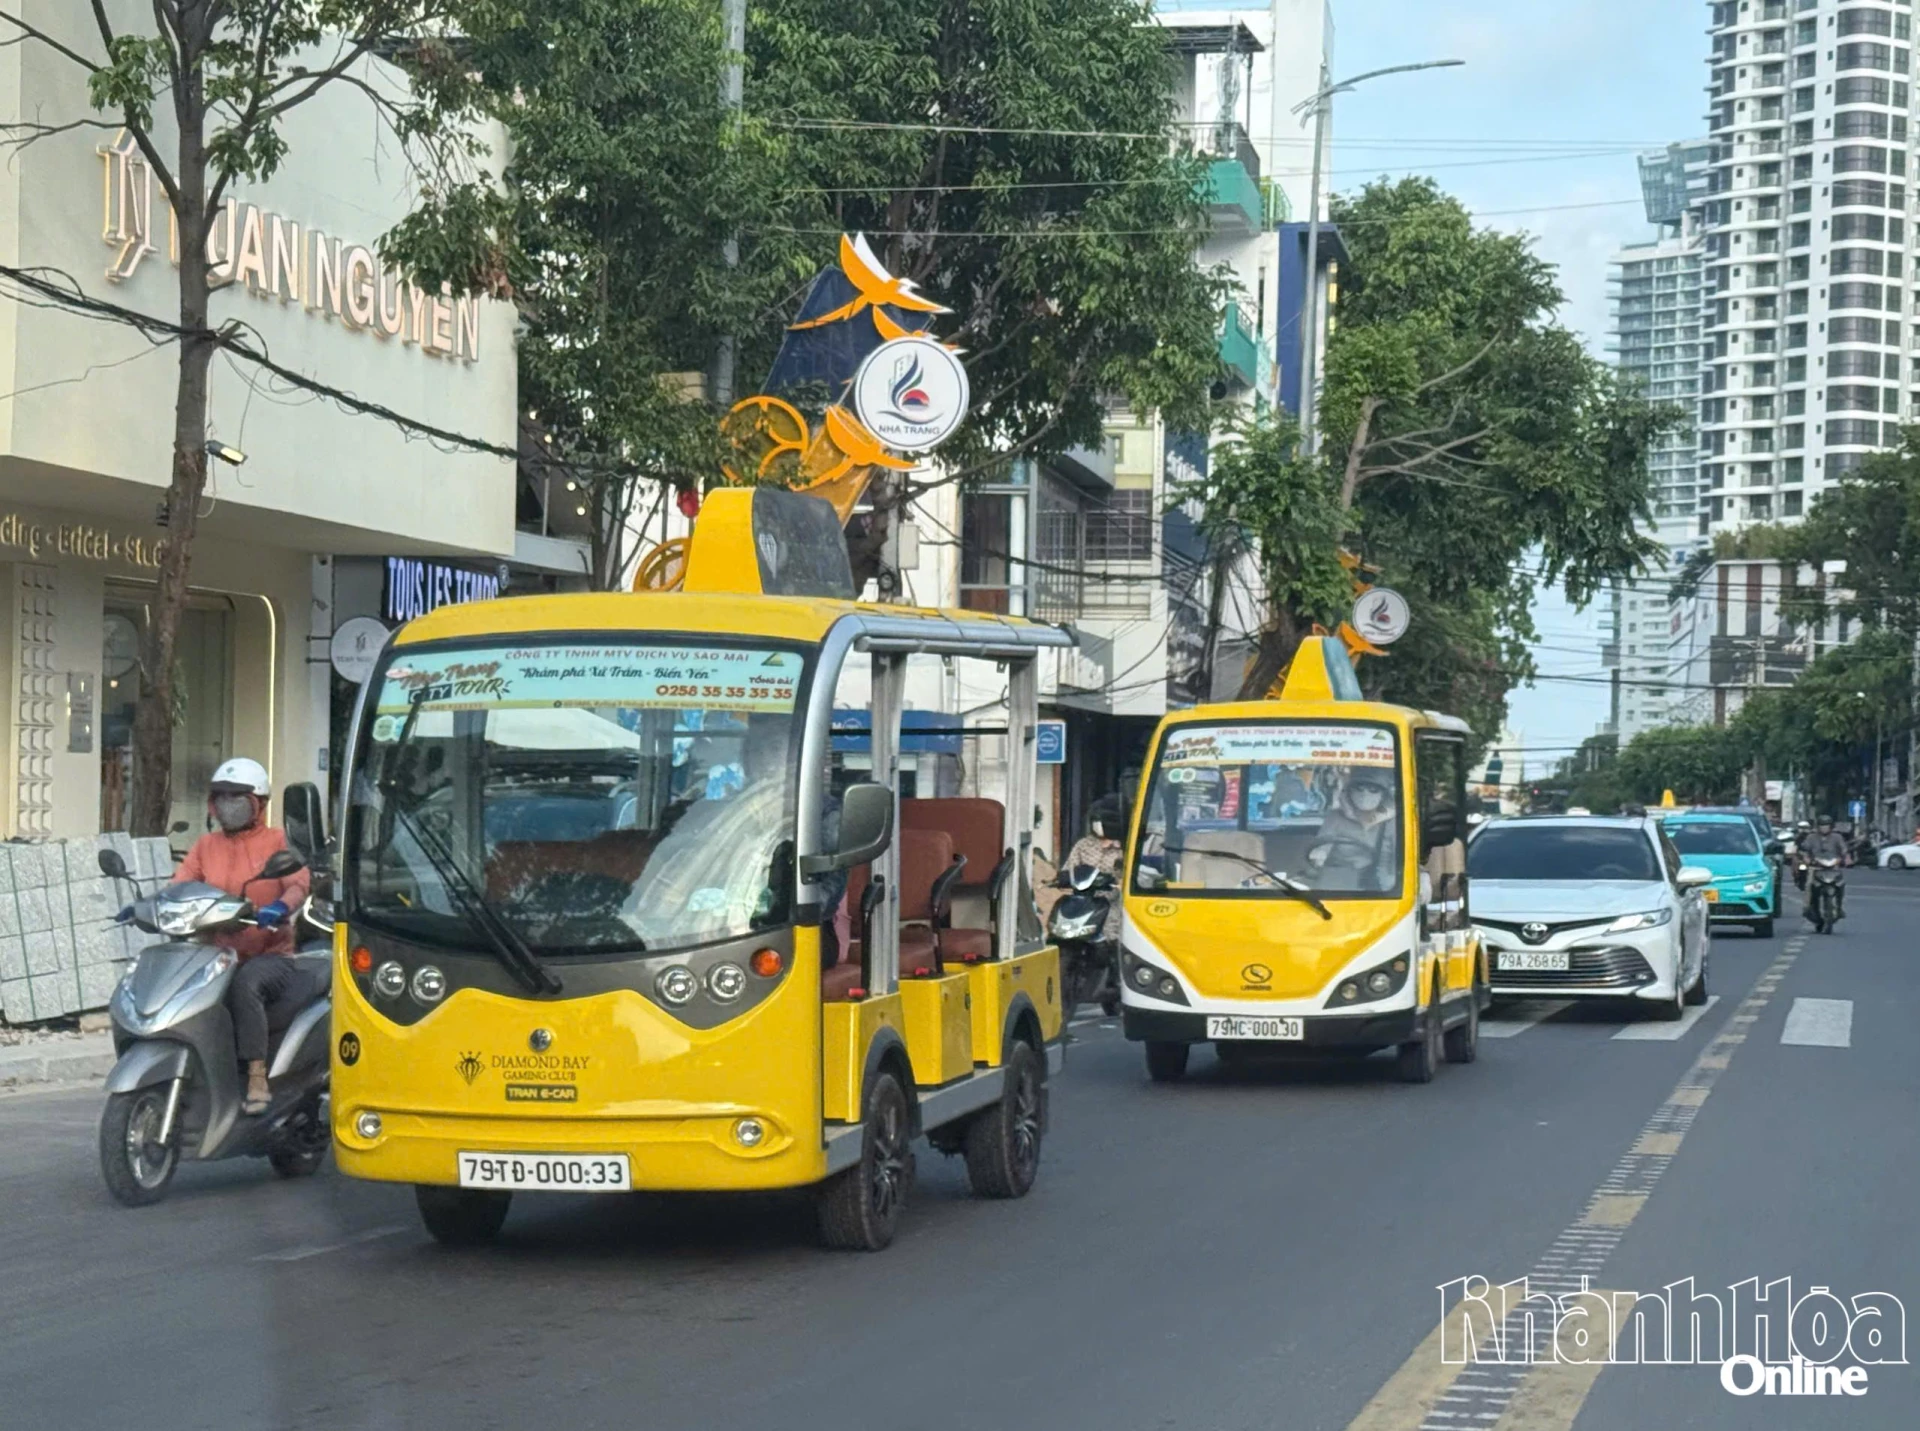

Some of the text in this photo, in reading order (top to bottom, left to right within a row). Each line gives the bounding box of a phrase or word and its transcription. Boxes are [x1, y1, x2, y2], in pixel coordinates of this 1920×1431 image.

[878, 425, 941, 435] NHA TRANG
[388, 556, 425, 621] TOUS
[505, 649, 749, 662] CÔNG TY TNHH MTV DỊCH VỤ SAO MAI
[409, 677, 504, 703] CTY TOUR
[656, 685, 793, 699] 0258 35 35 35 35
[342, 1040, 358, 1058] 09
[491, 1055, 590, 1069] DIAMOND BAY
[503, 1070, 576, 1081] GAMING CLUB
[507, 1087, 537, 1099] TRAN
